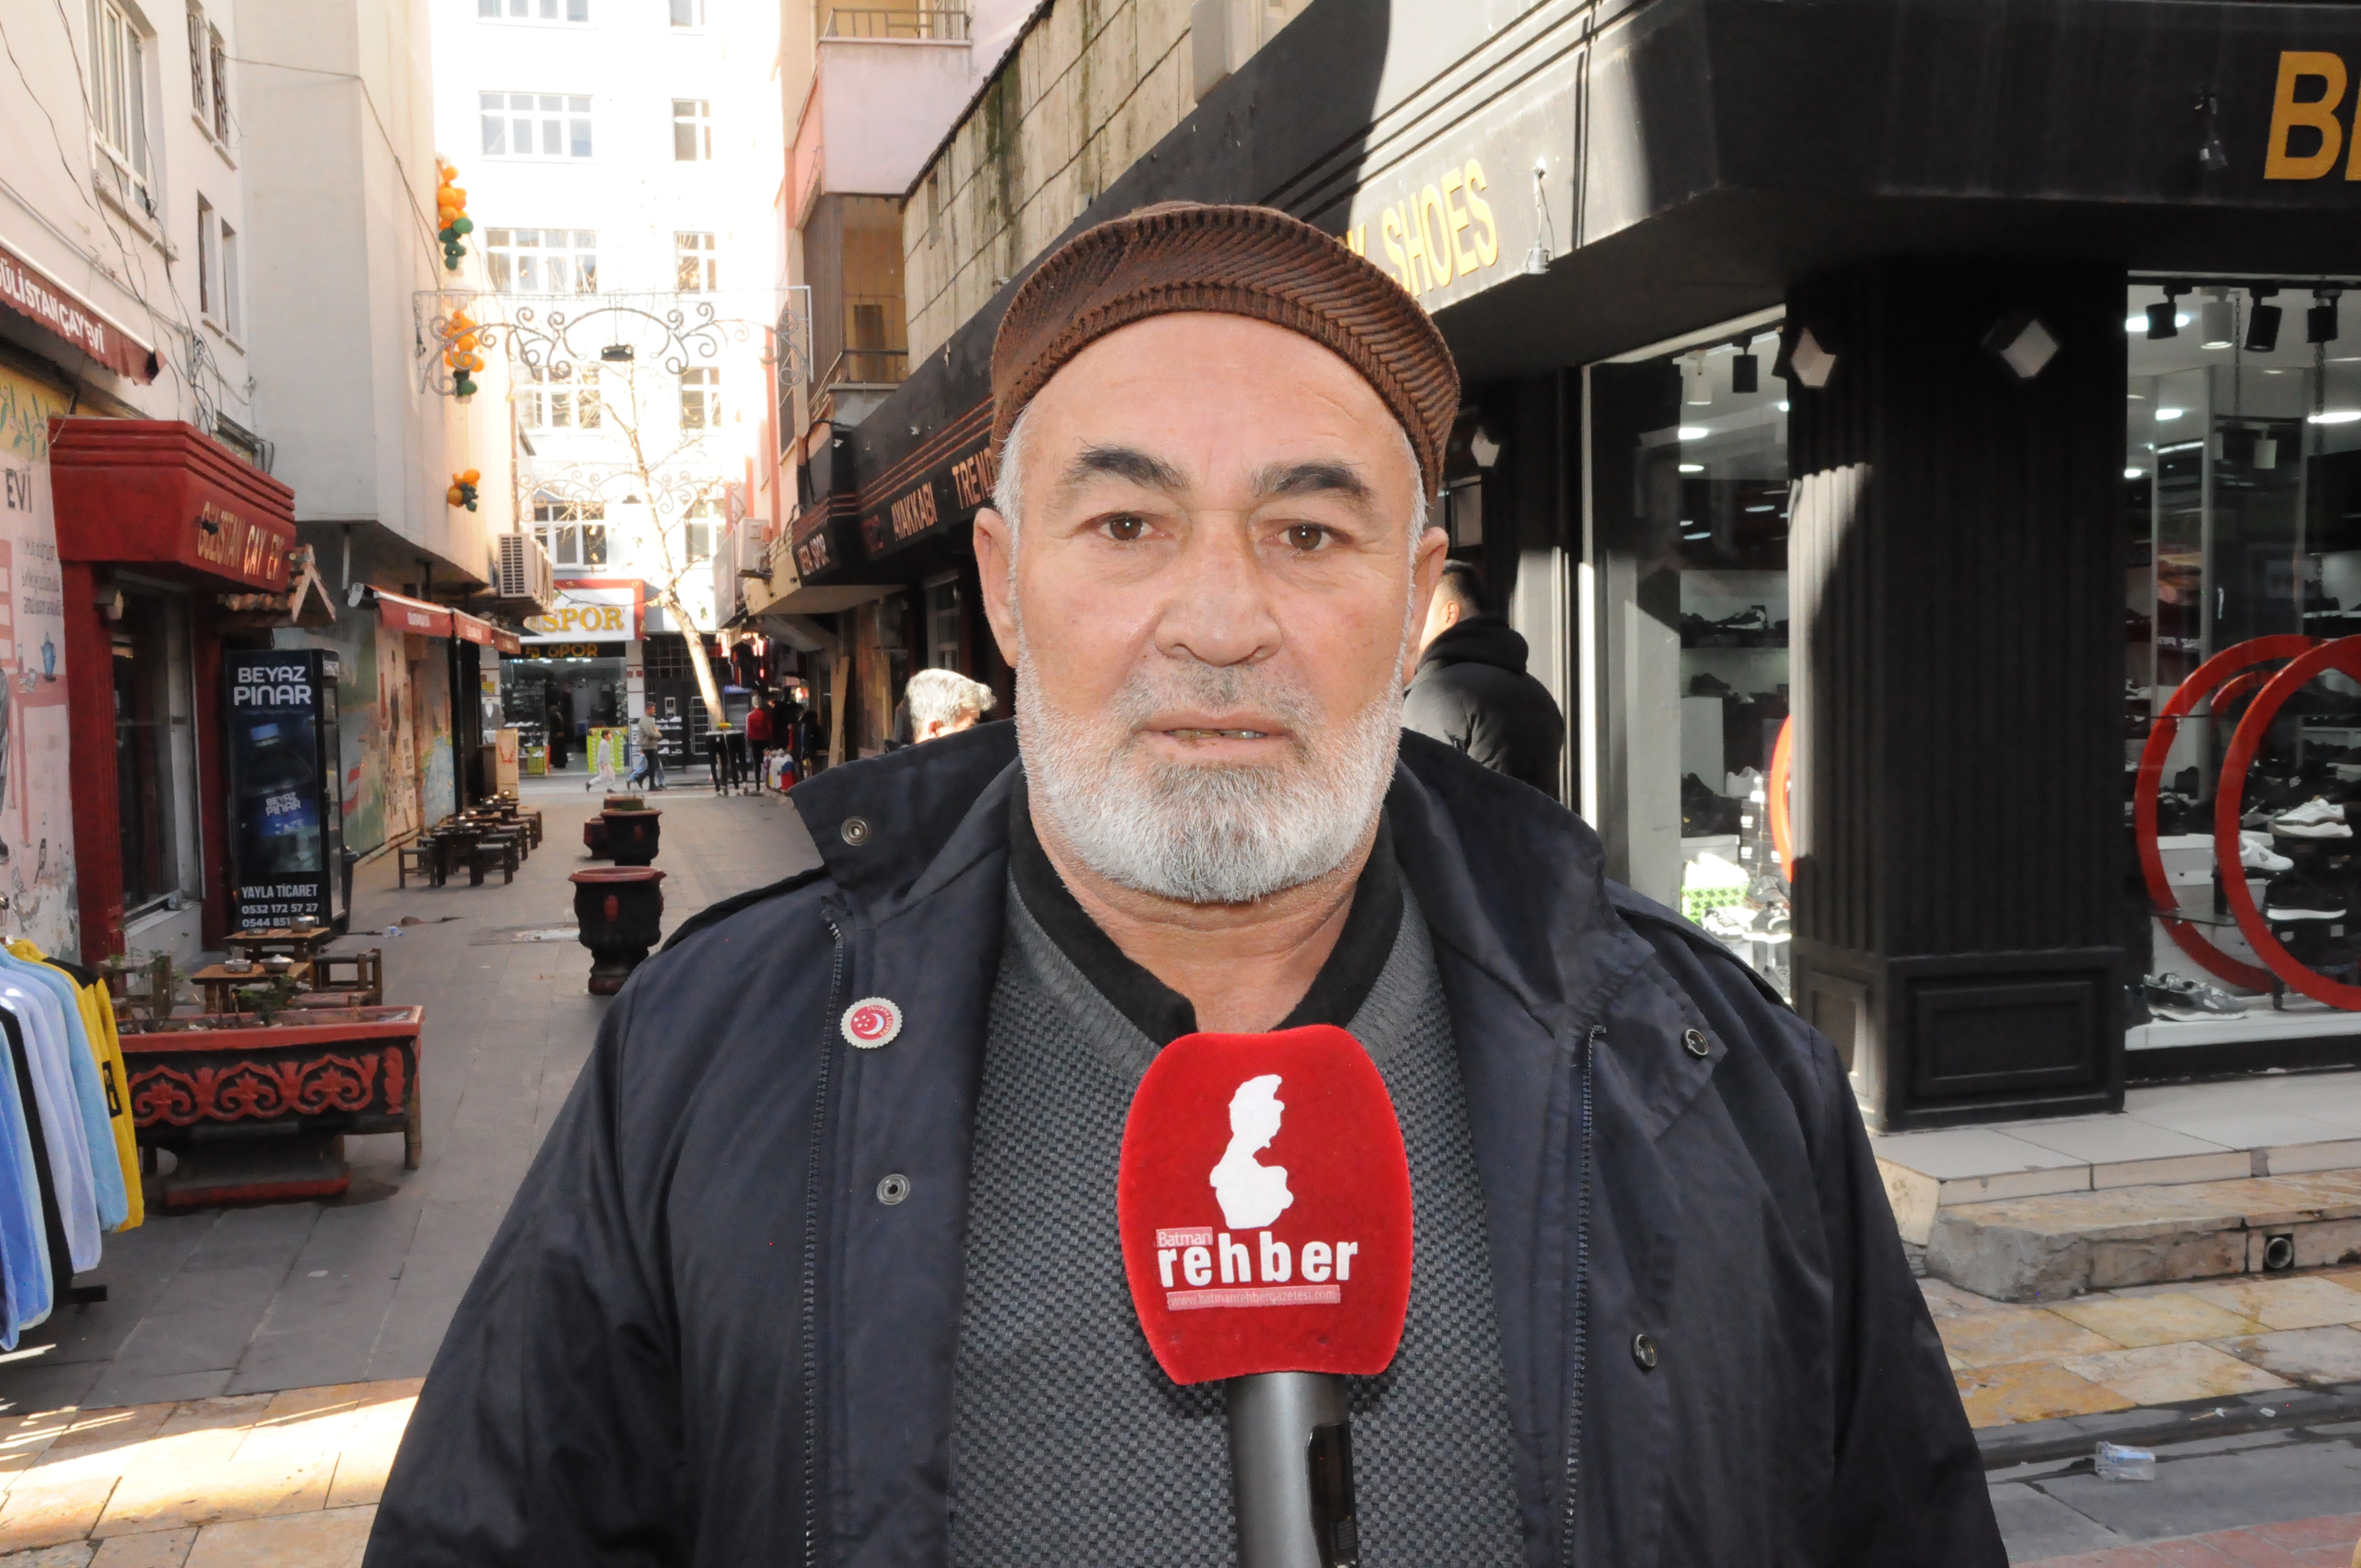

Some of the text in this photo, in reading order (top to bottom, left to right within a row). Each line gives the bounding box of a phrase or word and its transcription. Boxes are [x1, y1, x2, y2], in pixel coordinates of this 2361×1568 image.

[2264, 51, 2361, 181] B
[1381, 158, 1498, 297] SHOES
[0, 257, 59, 324] ÜLİSTAN
[891, 481, 938, 542] AYAKKABI
[542, 606, 624, 632] SPOR
[238, 666, 306, 683] BEYAZ
[233, 684, 312, 706] PINAR
[265, 792, 297, 806] BEYAZ
[265, 799, 302, 816] PINAR
[241, 883, 318, 899] YAYLA TİCARET
[241, 902, 318, 914] 0532 172 57 27
[242, 918, 270, 927] 0544
[1158, 1231, 1211, 1247] Batman
[1157, 1231, 1358, 1287] rehber
[1171, 1289, 1336, 1306] www.batmanrehbergazetesi.com
